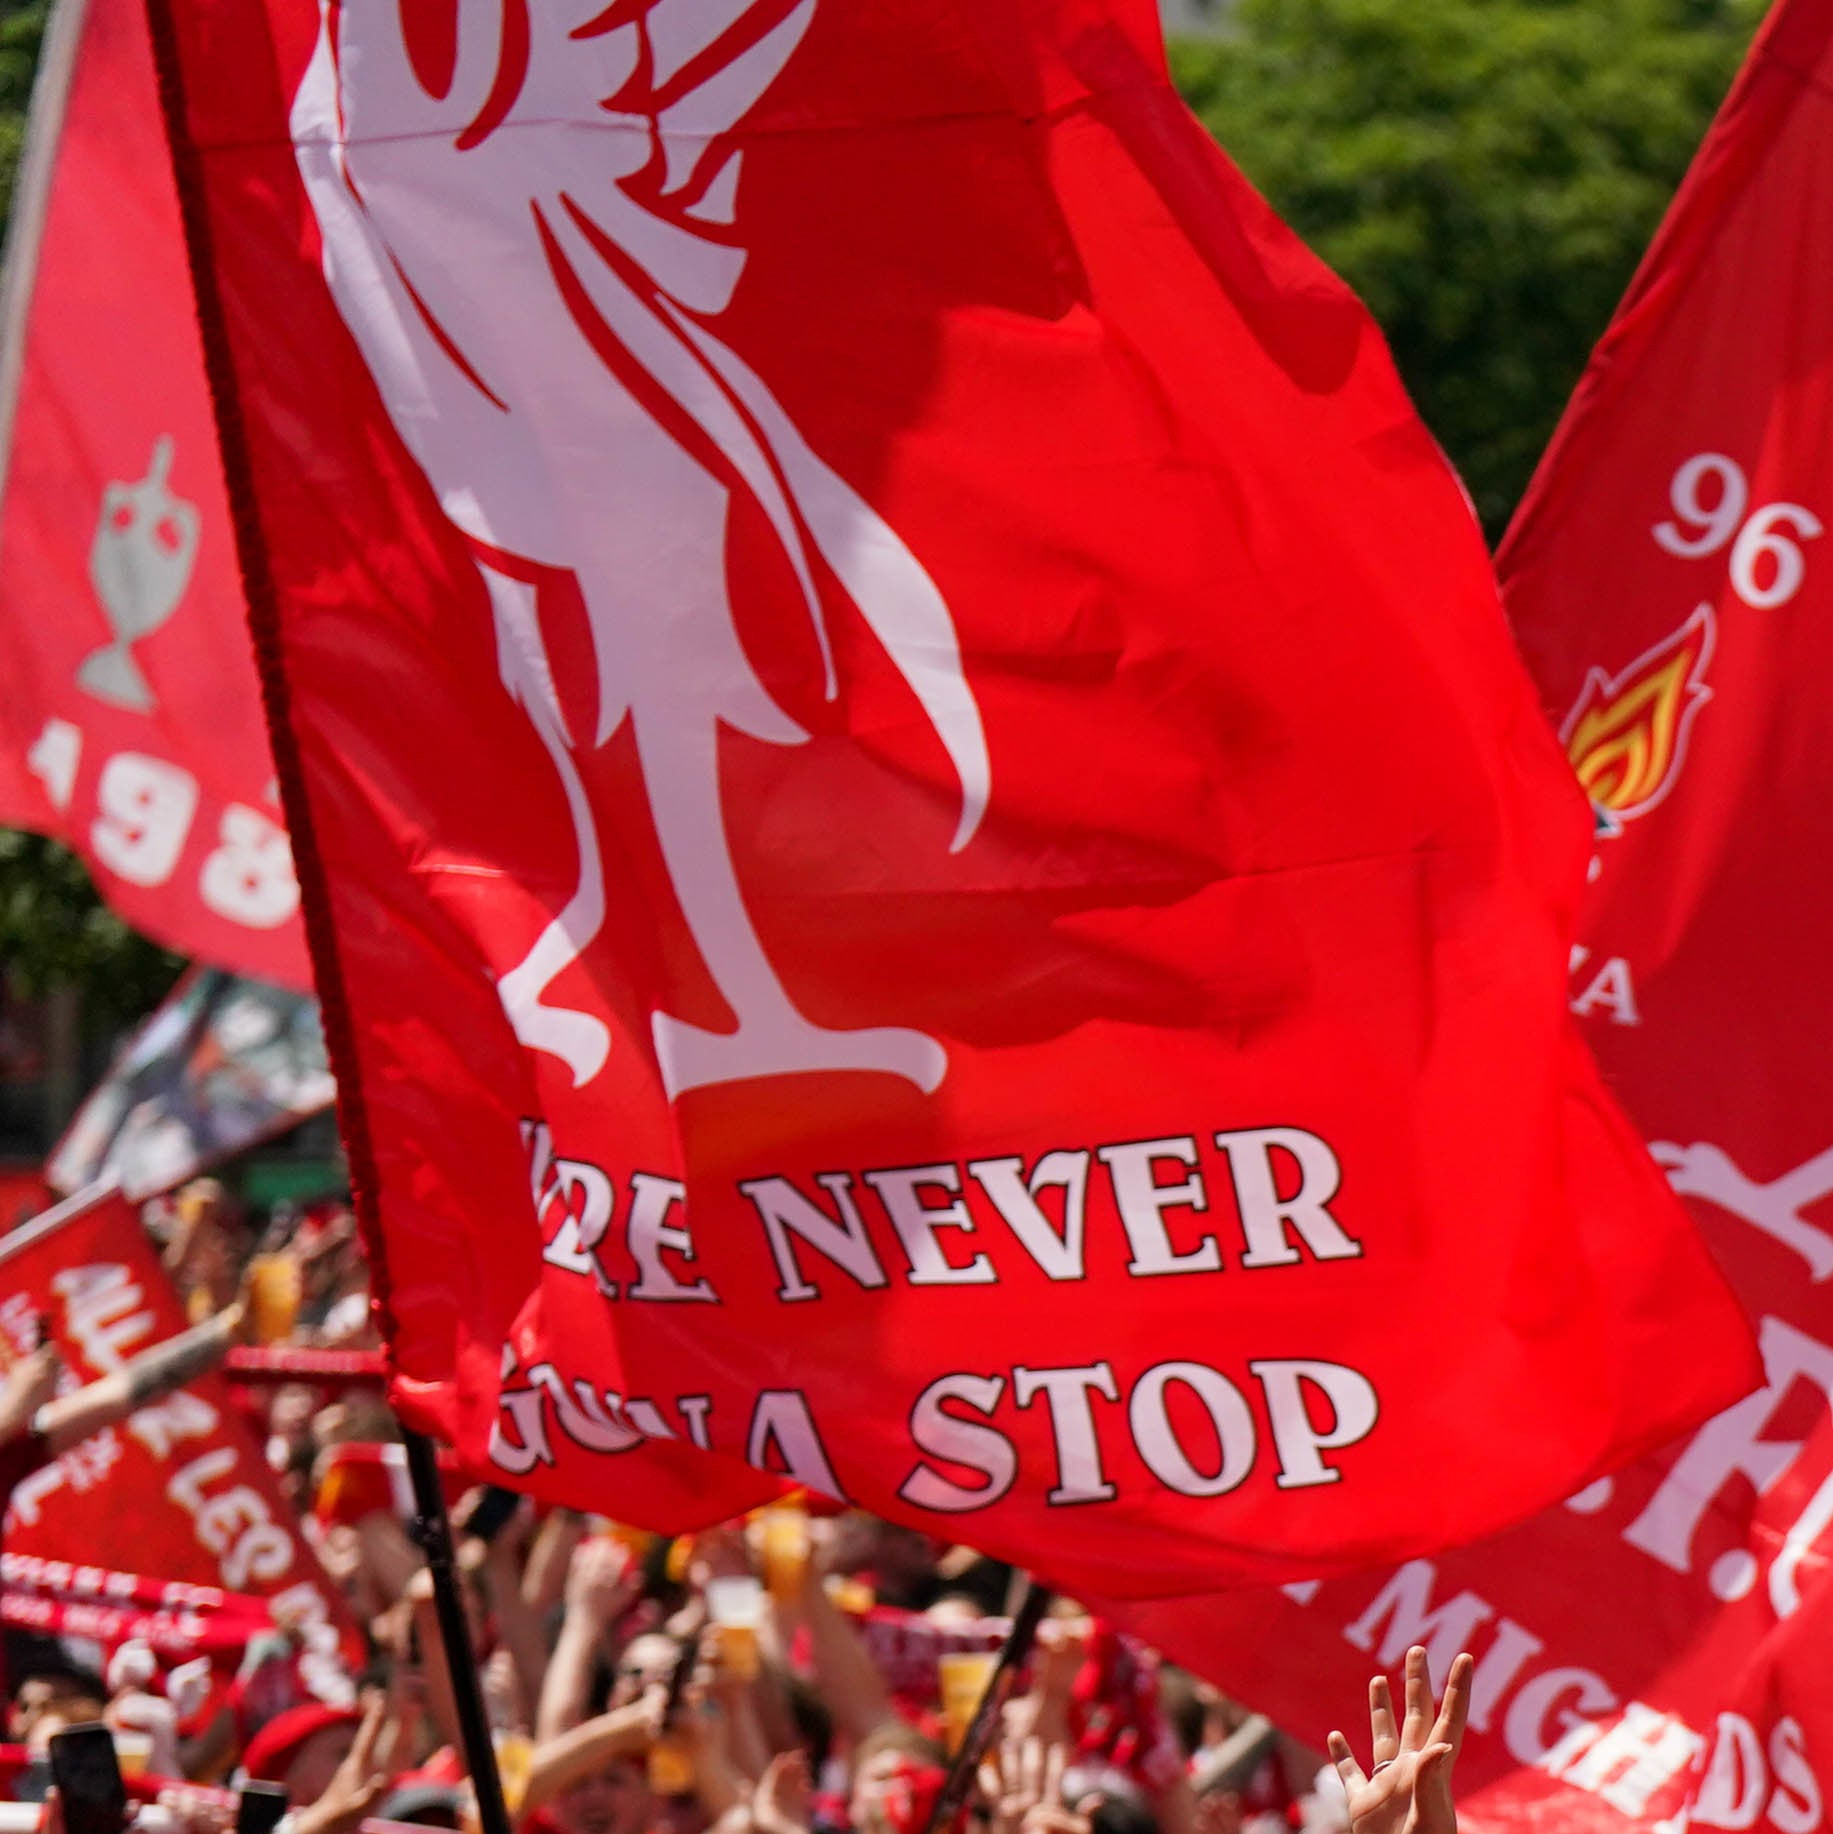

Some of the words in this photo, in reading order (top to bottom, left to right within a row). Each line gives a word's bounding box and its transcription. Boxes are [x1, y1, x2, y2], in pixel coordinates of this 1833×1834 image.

[1652, 453, 1822, 609] 96
[739, 1126, 1363, 1303] NEVER
[899, 1359, 1380, 1513] STOP
